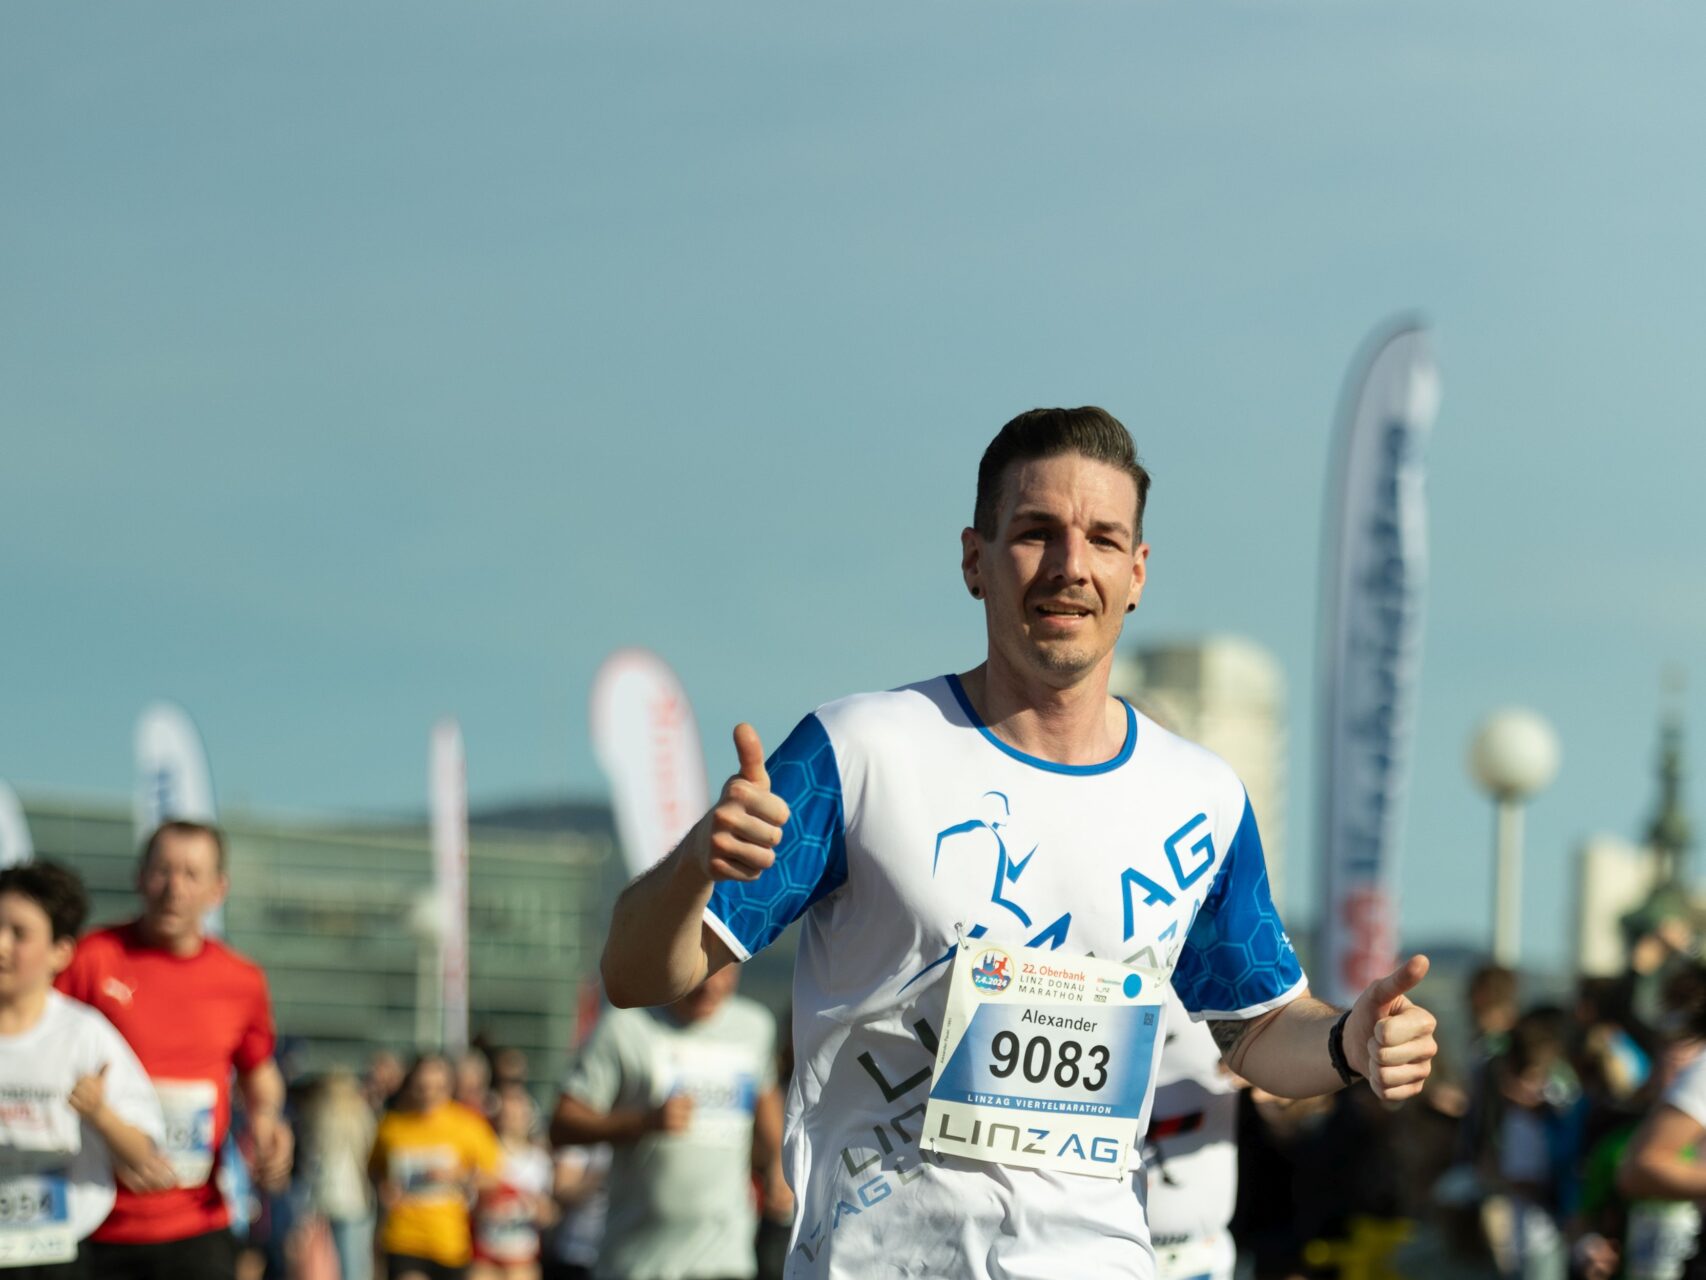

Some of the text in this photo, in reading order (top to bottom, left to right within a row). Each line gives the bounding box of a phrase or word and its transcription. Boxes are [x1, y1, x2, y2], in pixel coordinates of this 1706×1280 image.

[1121, 812, 1215, 942] AG
[1019, 975, 1044, 986] LINZ
[1048, 979, 1085, 992] DONAU
[1022, 963, 1037, 974] 22.
[1039, 966, 1086, 982] Oberbank
[1018, 985, 1084, 1002] MARATHON
[1021, 1008, 1098, 1033] Alexander
[988, 1030, 1110, 1092] 9083
[1015, 1099, 1112, 1114] VIERTELMARATHON
[938, 1113, 1119, 1164] LINZ AG
[833, 1174, 893, 1230] AG
